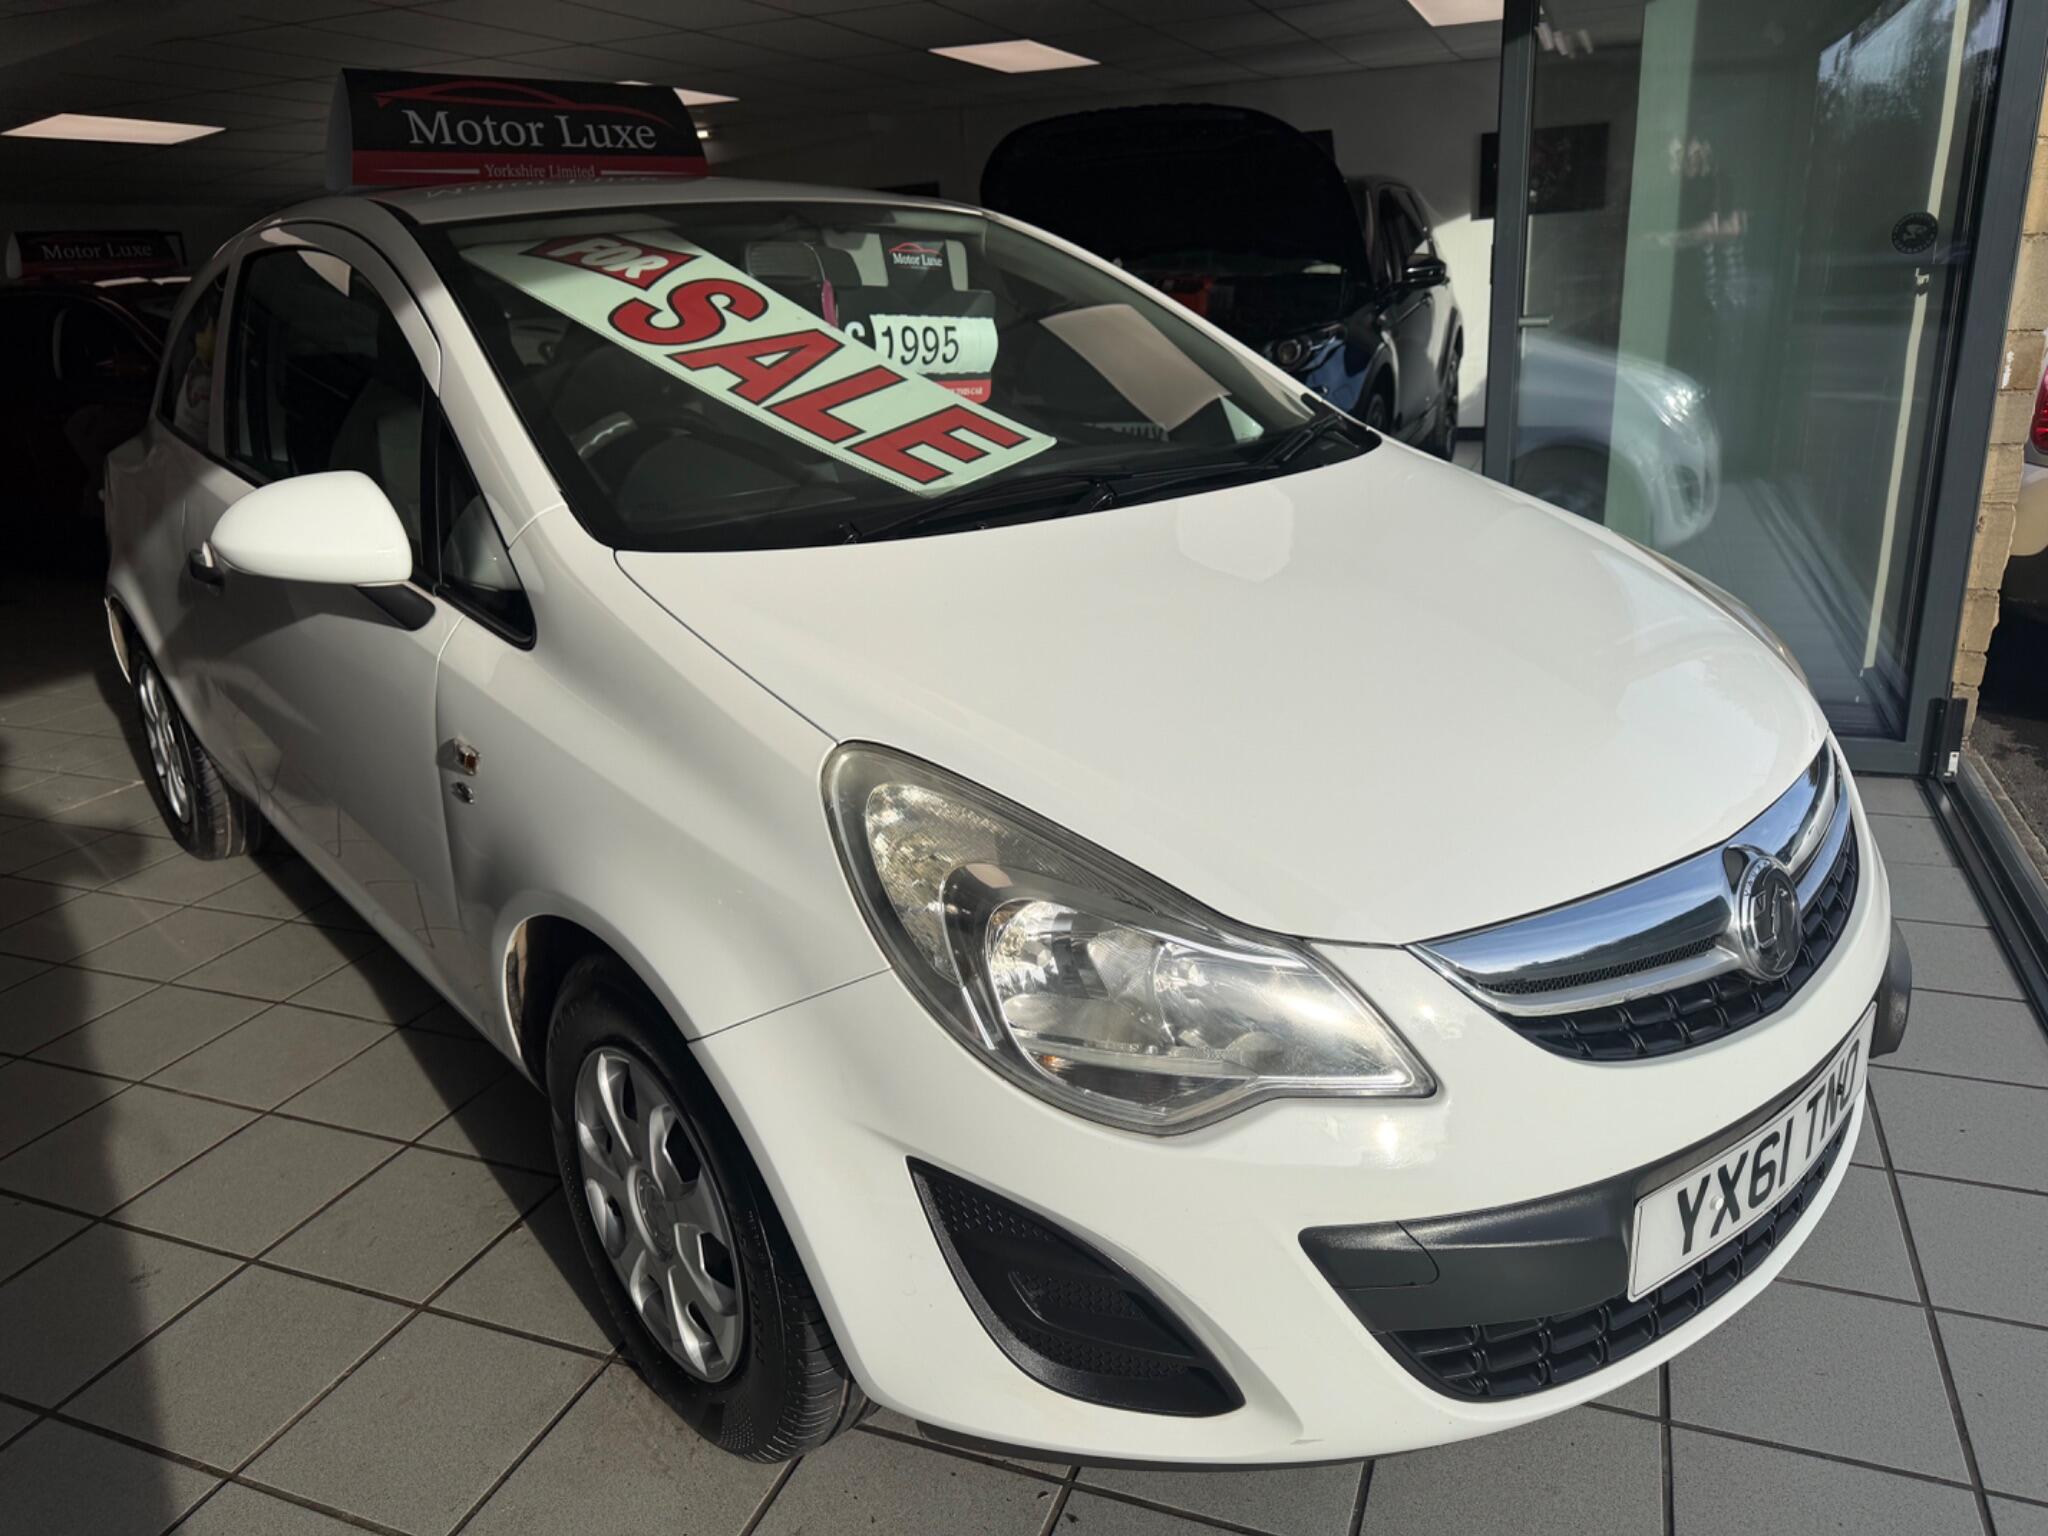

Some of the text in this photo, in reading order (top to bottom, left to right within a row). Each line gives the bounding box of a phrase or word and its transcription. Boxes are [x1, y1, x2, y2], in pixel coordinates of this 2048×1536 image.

[402, 109, 658, 150] Motor Luxe
[483, 163, 596, 178] Yorkshire Limited
[41, 242, 153, 260] Motor Luxe
[546, 237, 1031, 486] FOR SALE
[880, 324, 960, 367] 1995
[1676, 1116, 1795, 1257] YX61
